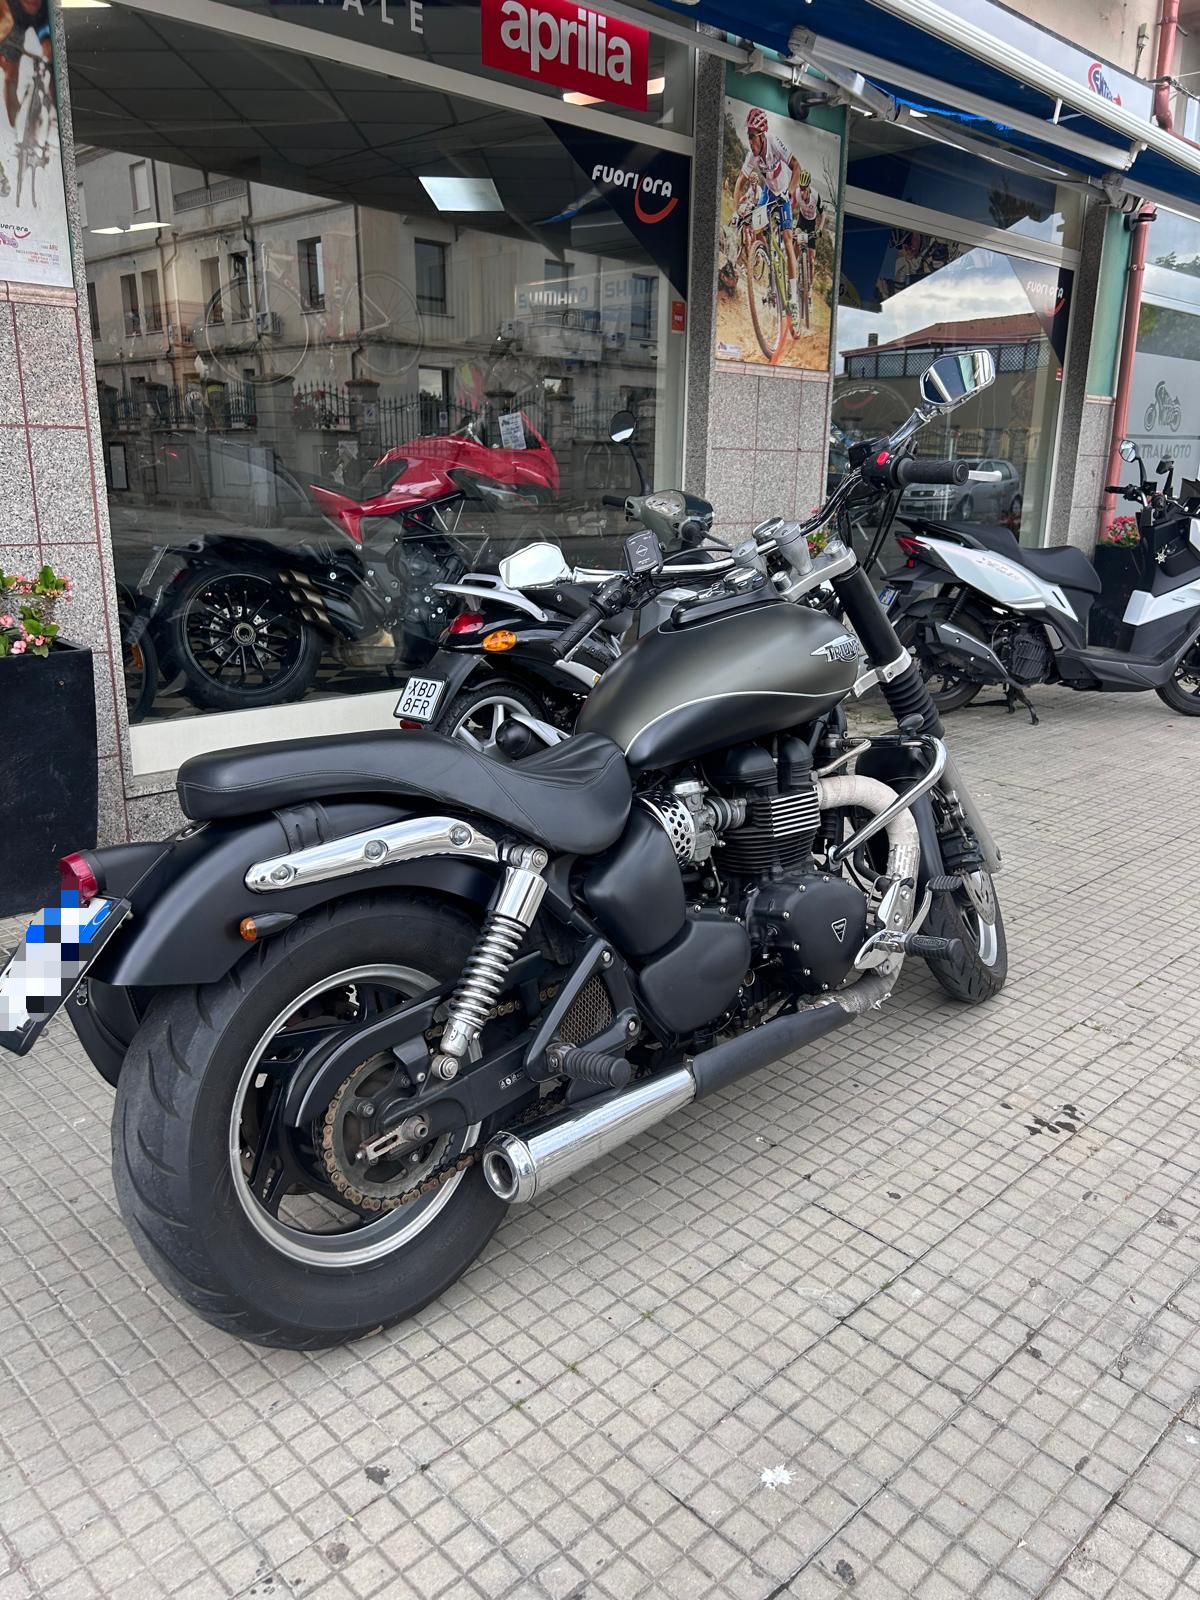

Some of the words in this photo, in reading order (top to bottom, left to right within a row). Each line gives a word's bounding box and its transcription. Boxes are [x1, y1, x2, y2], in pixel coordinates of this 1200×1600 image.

[500, 0, 632, 85] aprilia
[409, 681, 437, 698] XBD
[402, 697, 430, 716] 8FR
